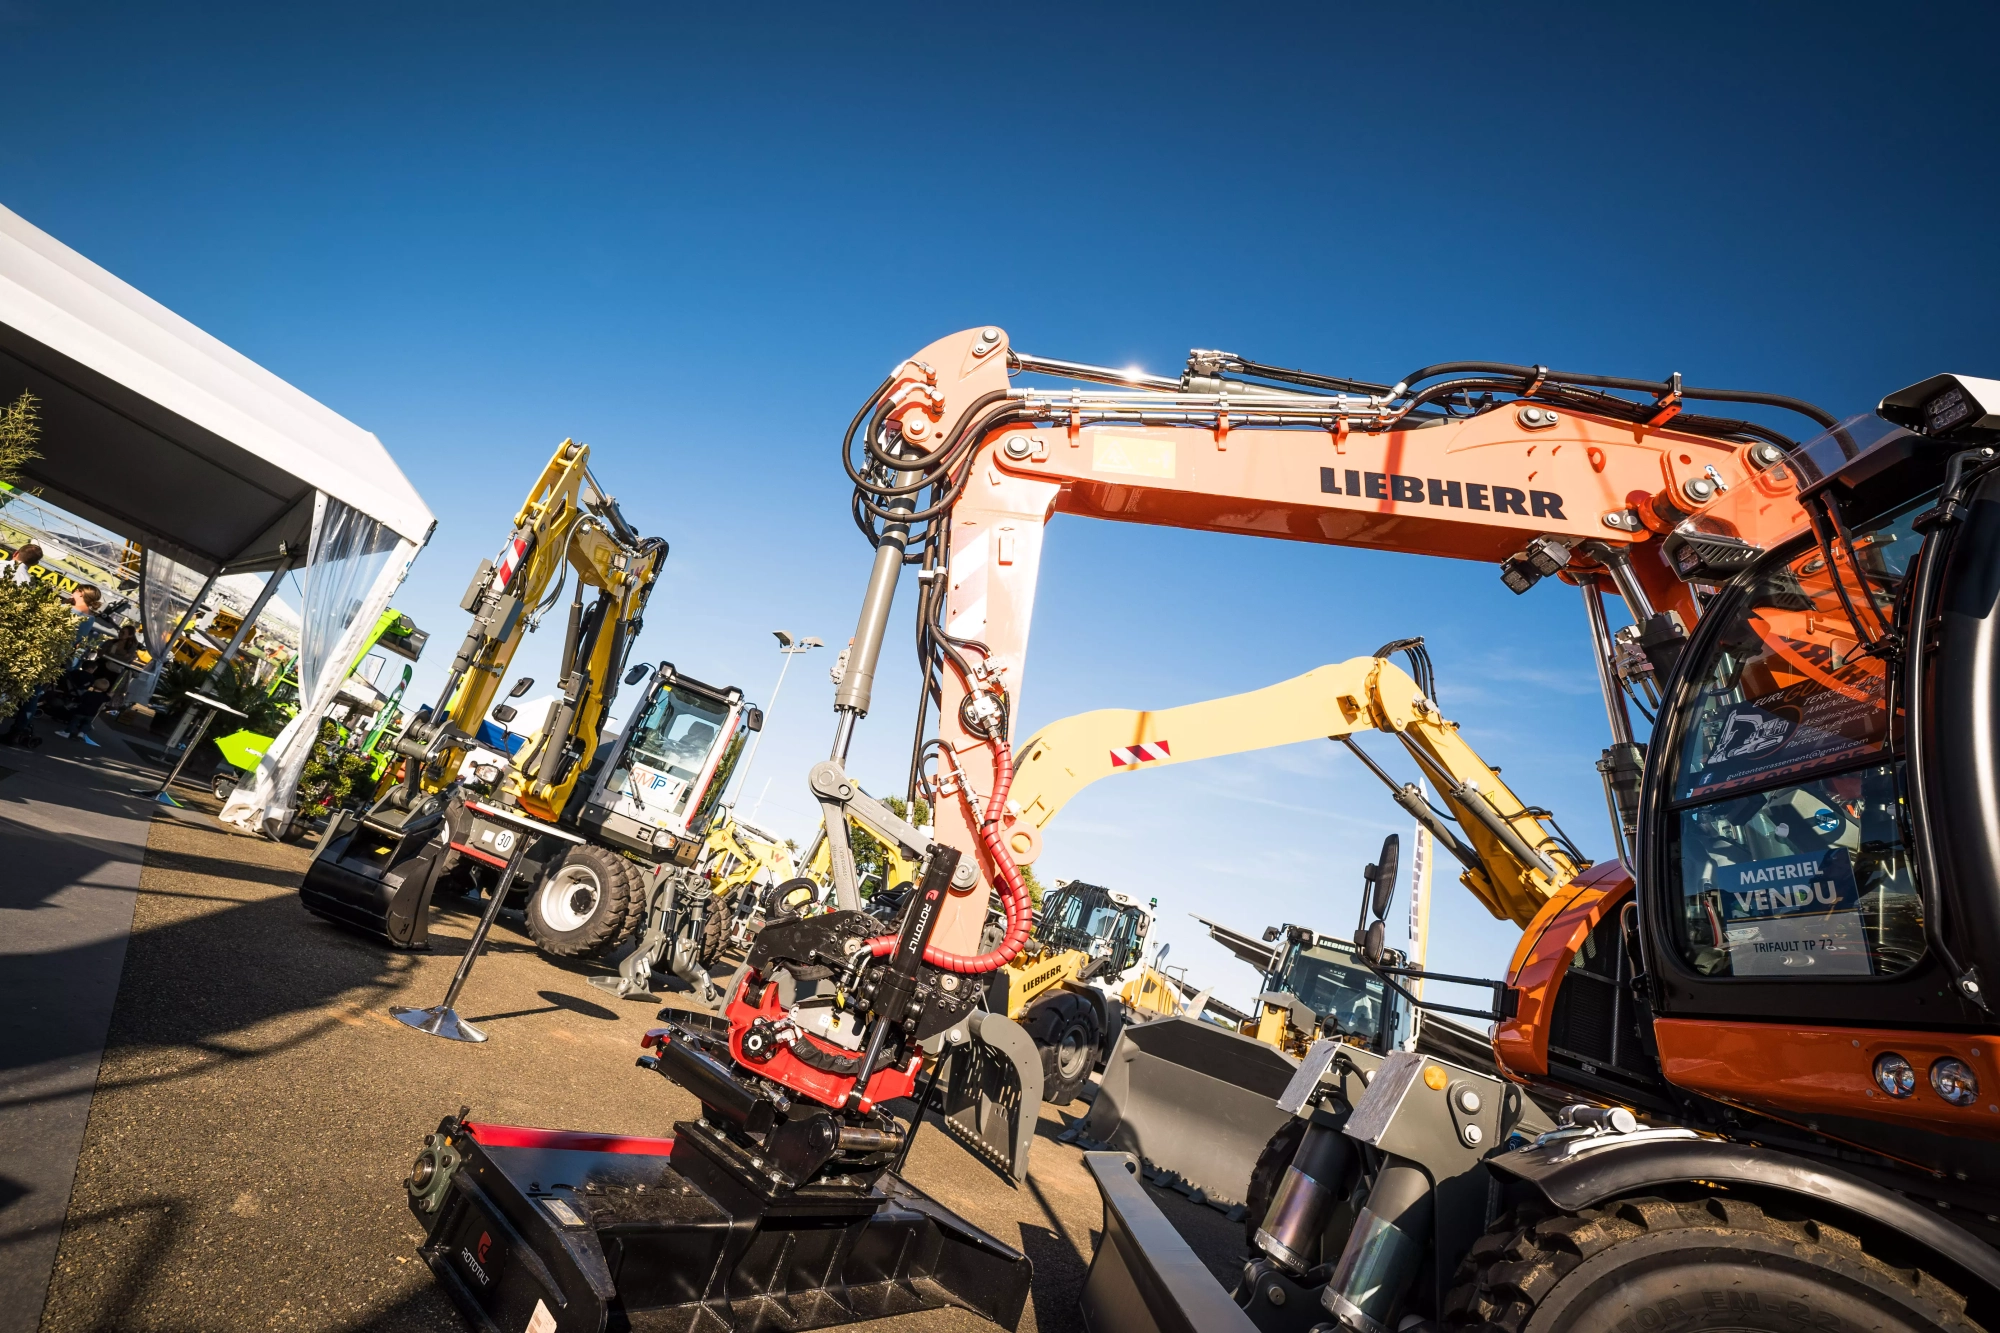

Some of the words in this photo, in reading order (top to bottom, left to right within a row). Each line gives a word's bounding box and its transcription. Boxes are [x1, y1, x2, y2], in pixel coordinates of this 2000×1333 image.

[1320, 466, 1568, 521] LIEBHERR
[1753, 690, 1784, 708] EURL
[1803, 672, 1885, 706] TERRASSEME
[1804, 685, 1885, 715] AMENAGEMEN
[1795, 723, 1829, 738] Travaux
[1829, 710, 1868, 731] publics
[1801, 698, 1881, 727] Assainissement
[1785, 727, 1842, 749] Particuliers
[1726, 737, 1868, 781] guittonterrassement@gmail.com
[497, 833, 512, 848] 30
[1740, 860, 1824, 885] MATERIEL
[1733, 880, 1837, 912] VENDU
[908, 902, 932, 954] ROTOTILT
[1319, 940, 1357, 954] LIEBHER
[1753, 941, 1800, 953] TRIFAULT
[1802, 940, 1816, 951] TP
[1819, 939, 1834, 950] 72
[1023, 964, 1062, 993] LIEBHERR
[461, 1247, 490, 1286] ROTOTILT
